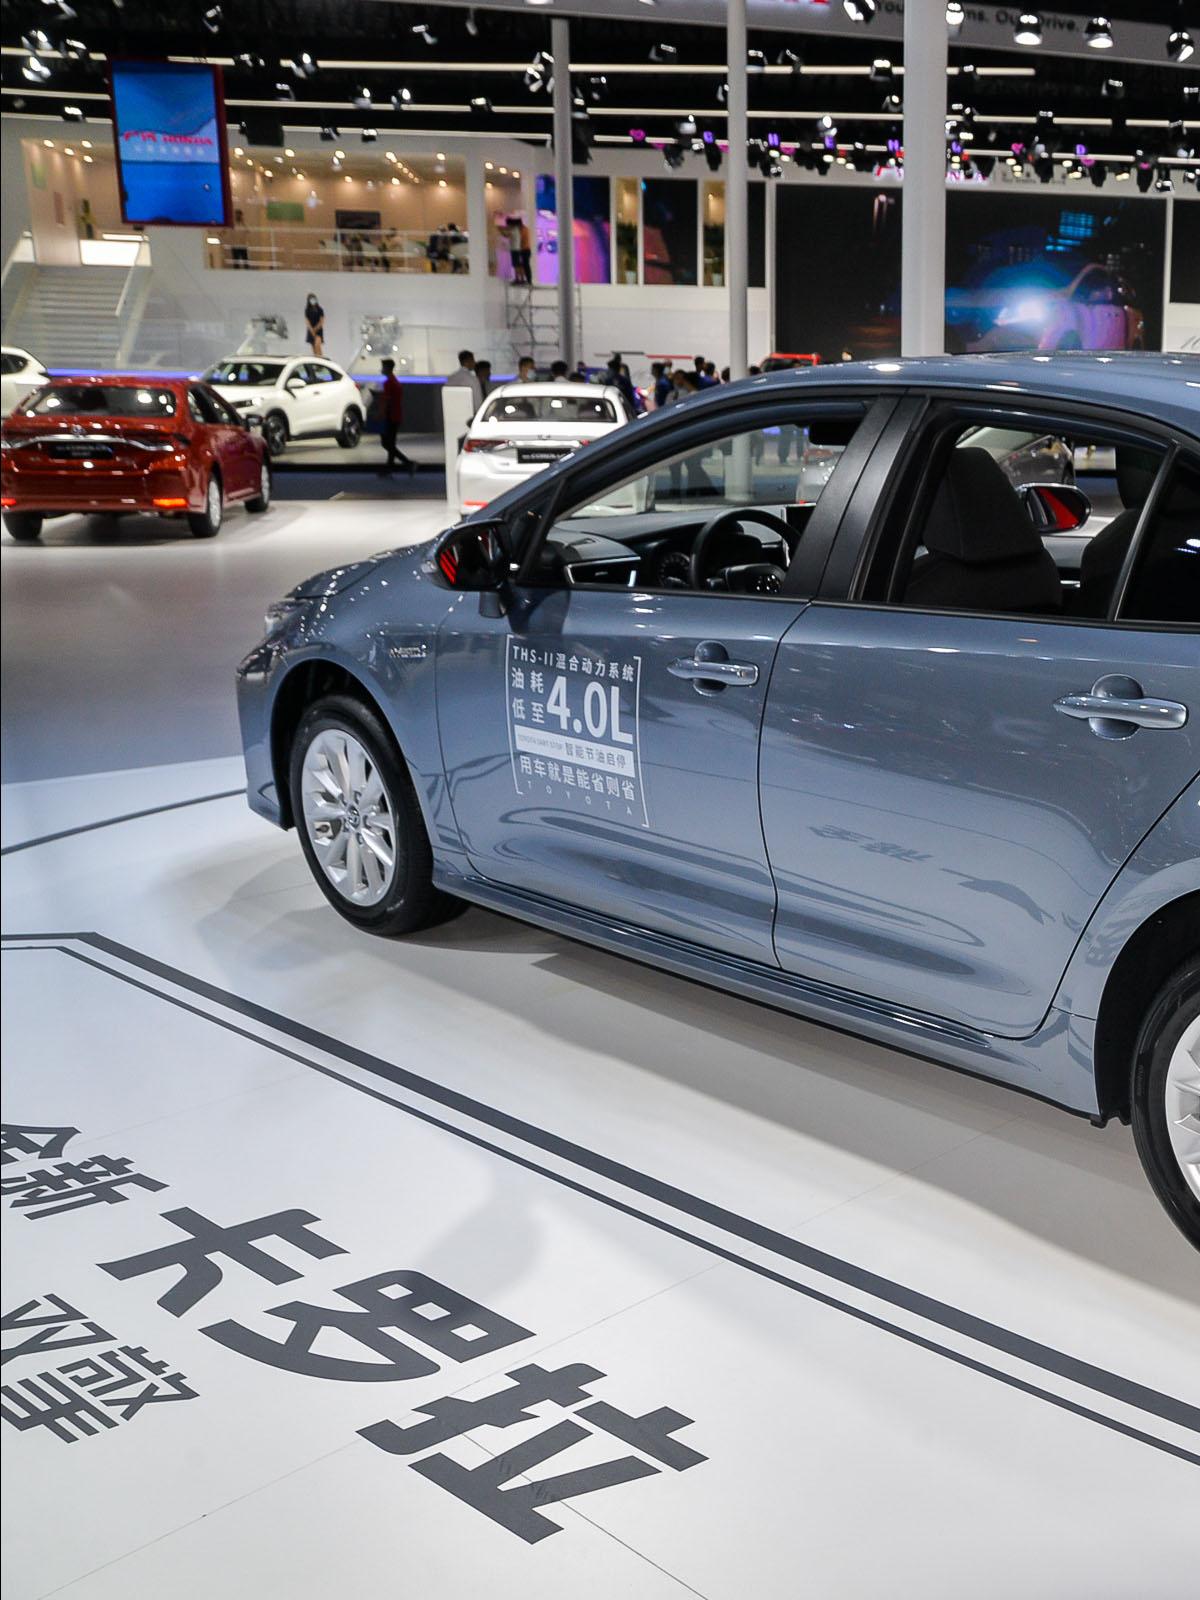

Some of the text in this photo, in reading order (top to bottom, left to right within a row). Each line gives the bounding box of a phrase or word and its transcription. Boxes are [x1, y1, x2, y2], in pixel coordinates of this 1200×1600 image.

[511, 667, 544, 694] 油耗
[511, 698, 545, 724] 低至
[546, 675, 633, 744] 4.0L
[520, 755, 635, 801] 用车就是能省则省
[96, 1206, 710, 1545] 卡罗拉
